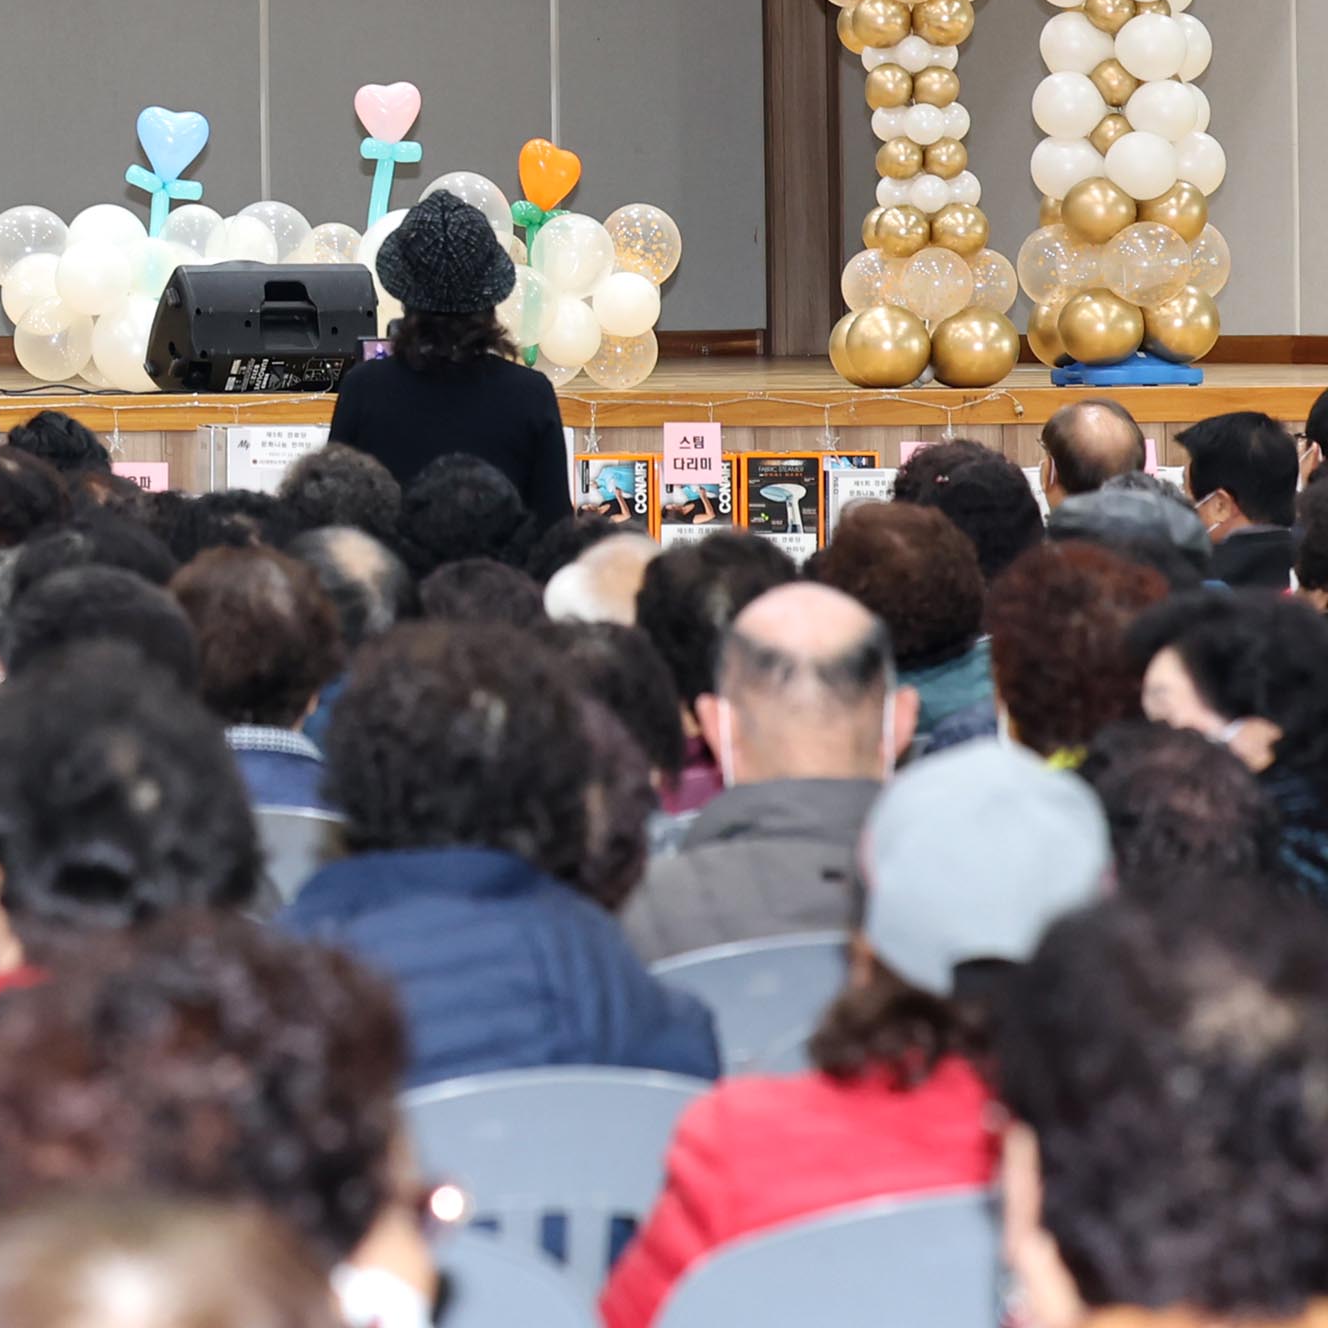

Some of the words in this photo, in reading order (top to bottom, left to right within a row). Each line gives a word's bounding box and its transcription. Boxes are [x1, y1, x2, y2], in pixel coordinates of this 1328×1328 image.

[679, 435, 705, 450] 스팀
[673, 456, 713, 471] 다리미
[634, 461, 648, 514] CONAIR
